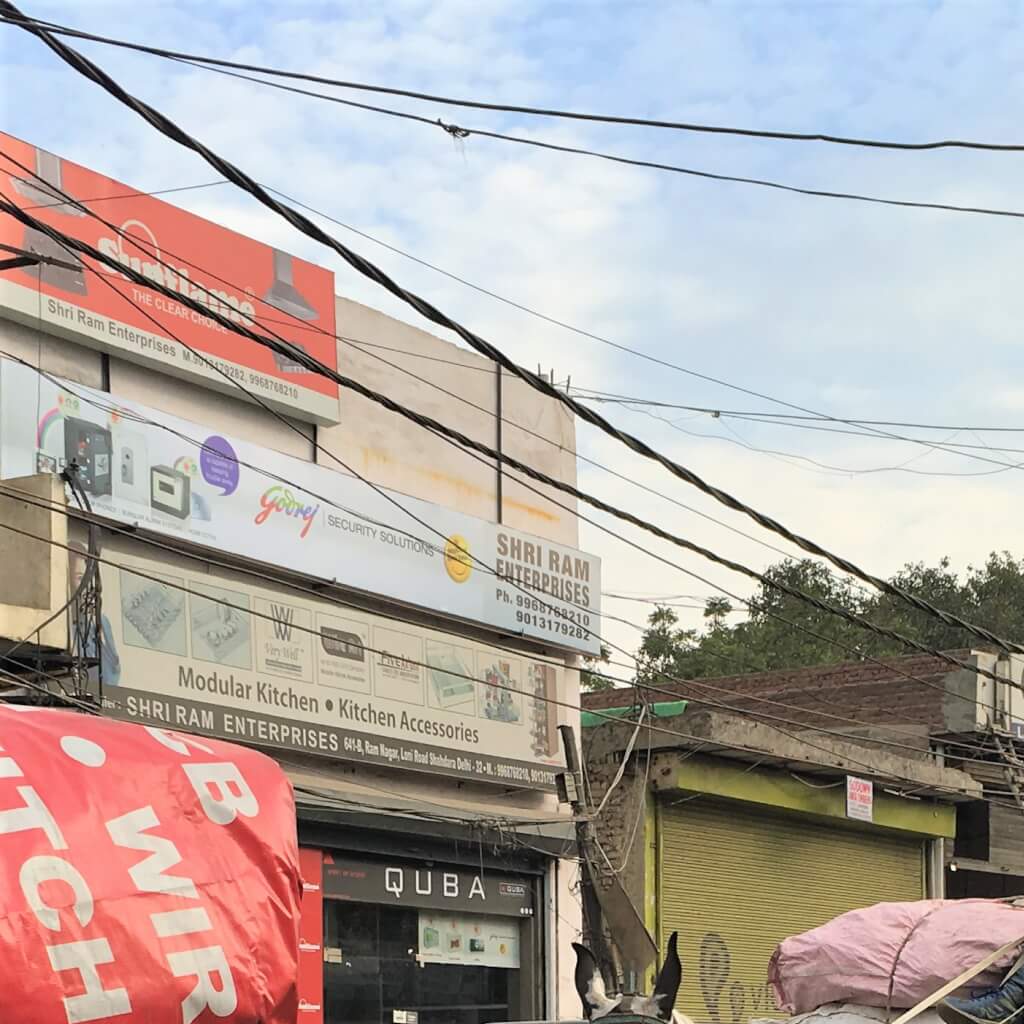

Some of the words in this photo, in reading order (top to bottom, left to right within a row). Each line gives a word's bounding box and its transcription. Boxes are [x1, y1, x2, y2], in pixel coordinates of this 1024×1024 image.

[47, 299, 74, 319] Shri
[77, 310, 105, 333] Ram
[107, 321, 177, 357] Enterprises
[132, 288, 153, 307] THE
[155, 301, 189, 322] CLEAR
[254, 485, 320, 539] Godrej
[327, 514, 378, 538] SECURITY
[379, 530, 435, 557] SOLUTIONS
[496, 533, 542, 567] SHRI
[548, 548, 590, 582] RAM
[496, 557, 590, 608] ENTERPRISES
[496, 588, 513, 604] Ph.
[515, 594, 591, 626] 9968768210
[515, 610, 591, 641] 9013179282
[177, 665, 253, 699] Modular
[256, 681, 319, 713] Kitchen
[126, 695, 170, 722] SHRI
[175, 704, 215, 730] RAM
[223, 713, 339, 751] ENTERPRISES
[339, 697, 397, 728] Kitchen
[399, 710, 480, 743] Accessories
[385, 867, 486, 900] QUBA
